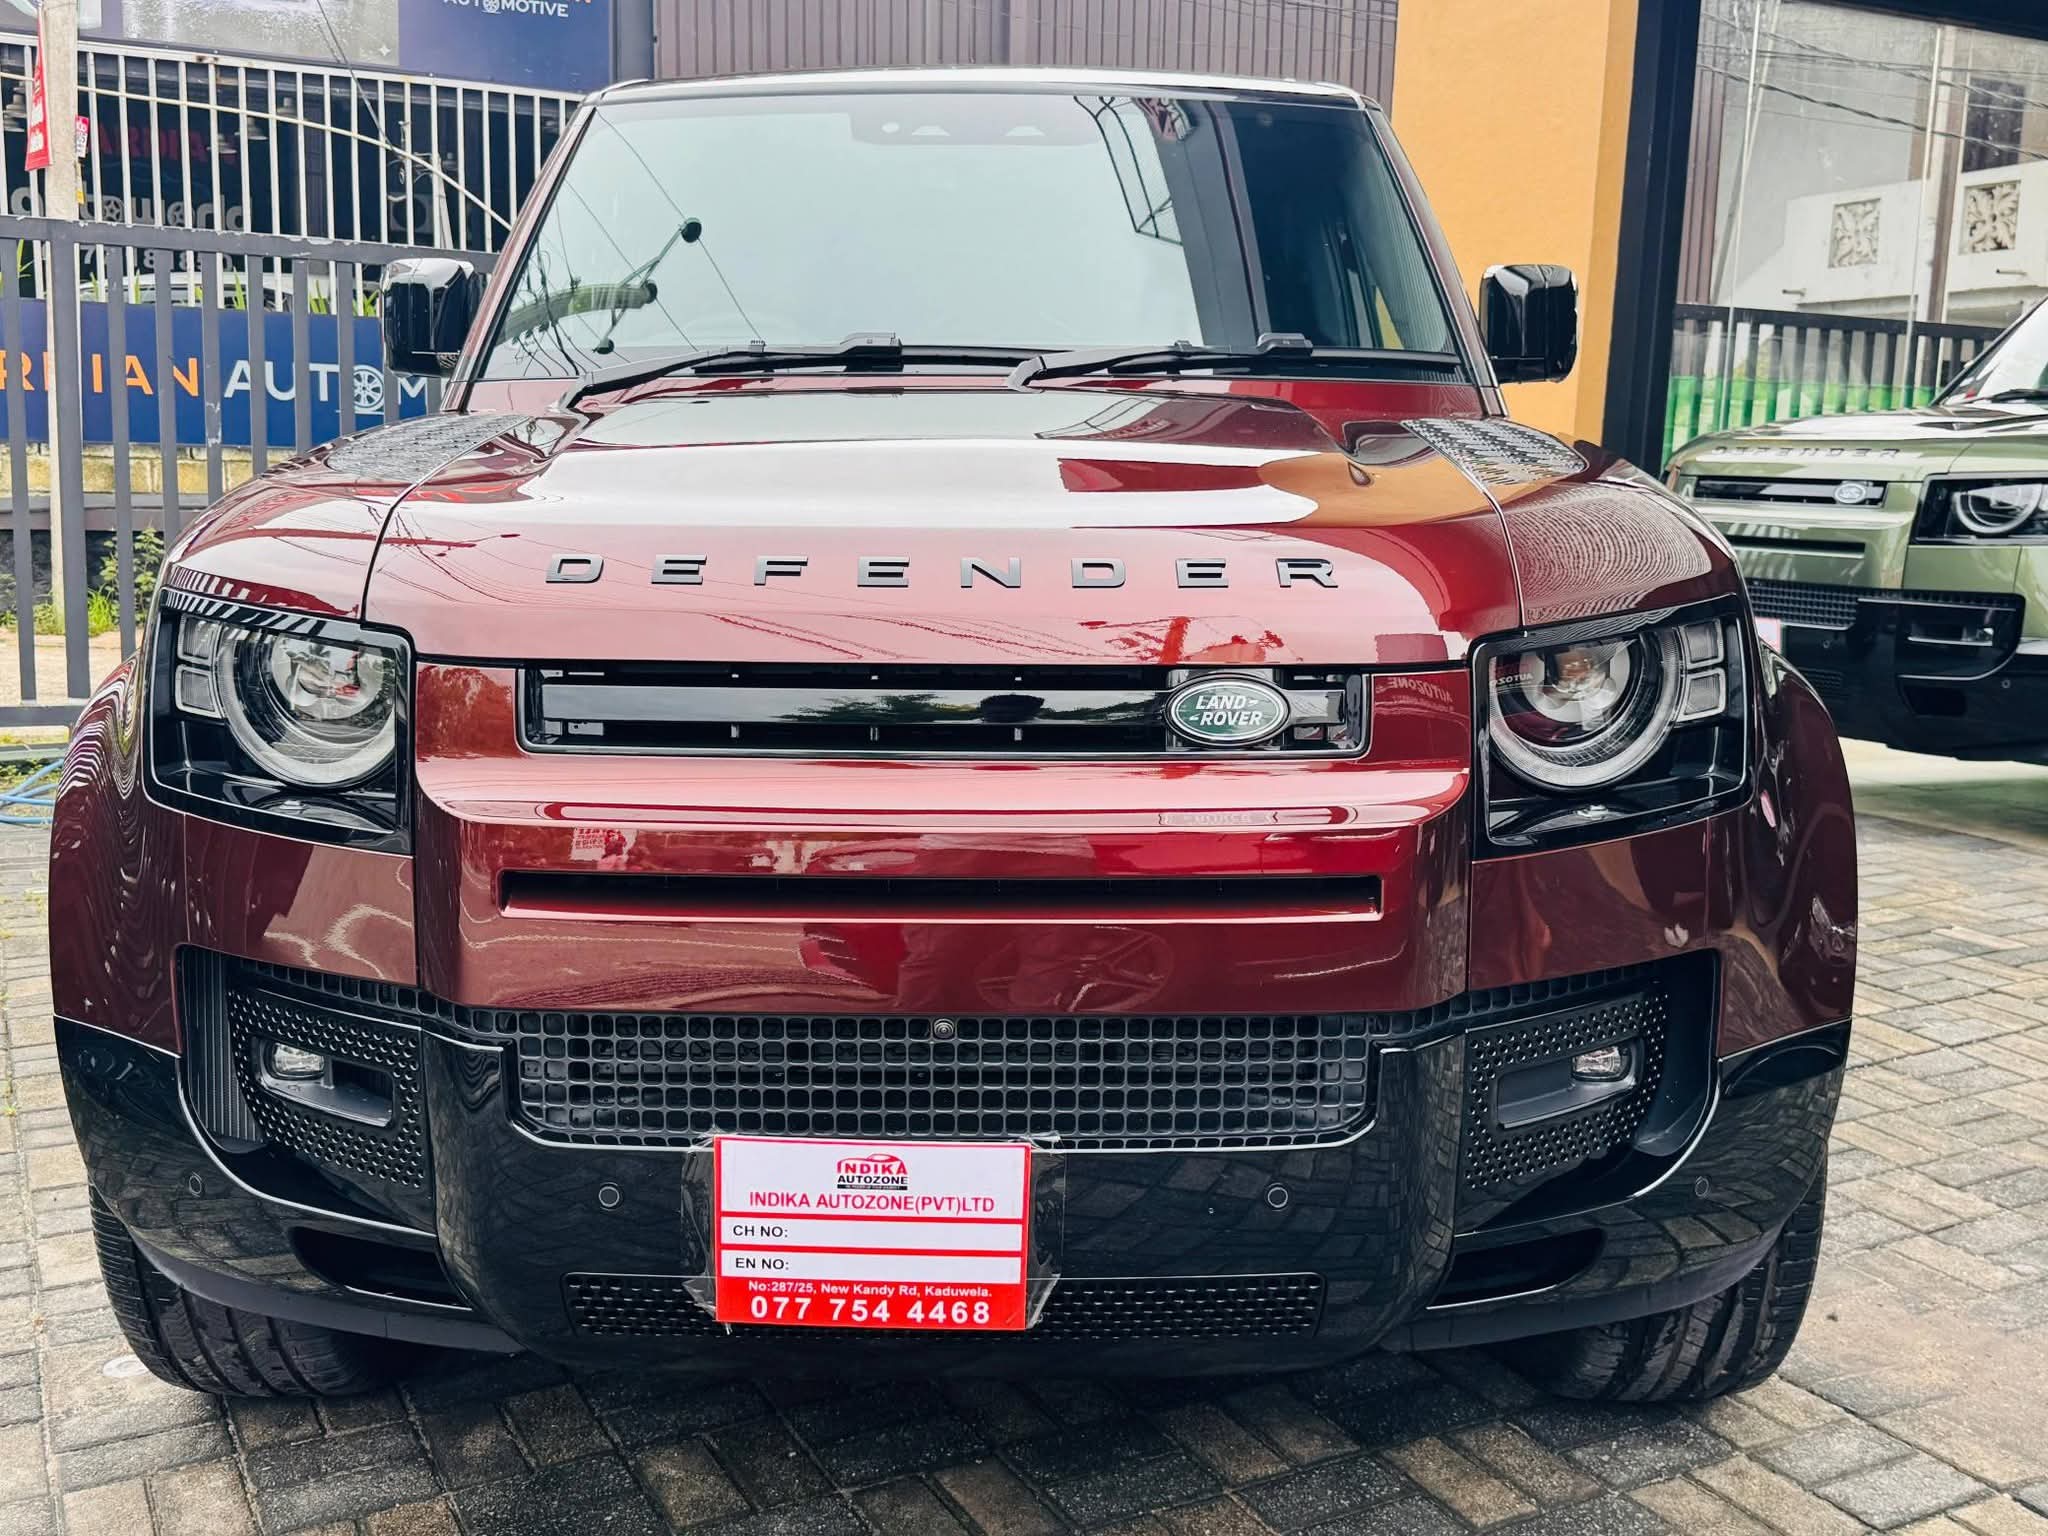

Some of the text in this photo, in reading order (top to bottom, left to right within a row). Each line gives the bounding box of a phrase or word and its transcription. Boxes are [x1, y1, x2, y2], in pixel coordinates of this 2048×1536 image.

[545, 553, 1339, 588] DEFENDER
[1195, 695, 1247, 710] LAND
[1199, 711, 1263, 726] ROVER
[837, 1160, 908, 1175] INDIKA
[837, 1175, 909, 1185] AUTOZONE
[749, 1191, 995, 1215] INDIKA AUTOZONE(PVT)LTD
[733, 1224, 788, 1238] CH NO:
[735, 1257, 789, 1270] EN NO:
[748, 1281, 993, 1298] No:287/25, New Kandy Rd, Kaduwela.
[750, 1296, 990, 1324] 077 754 4468
